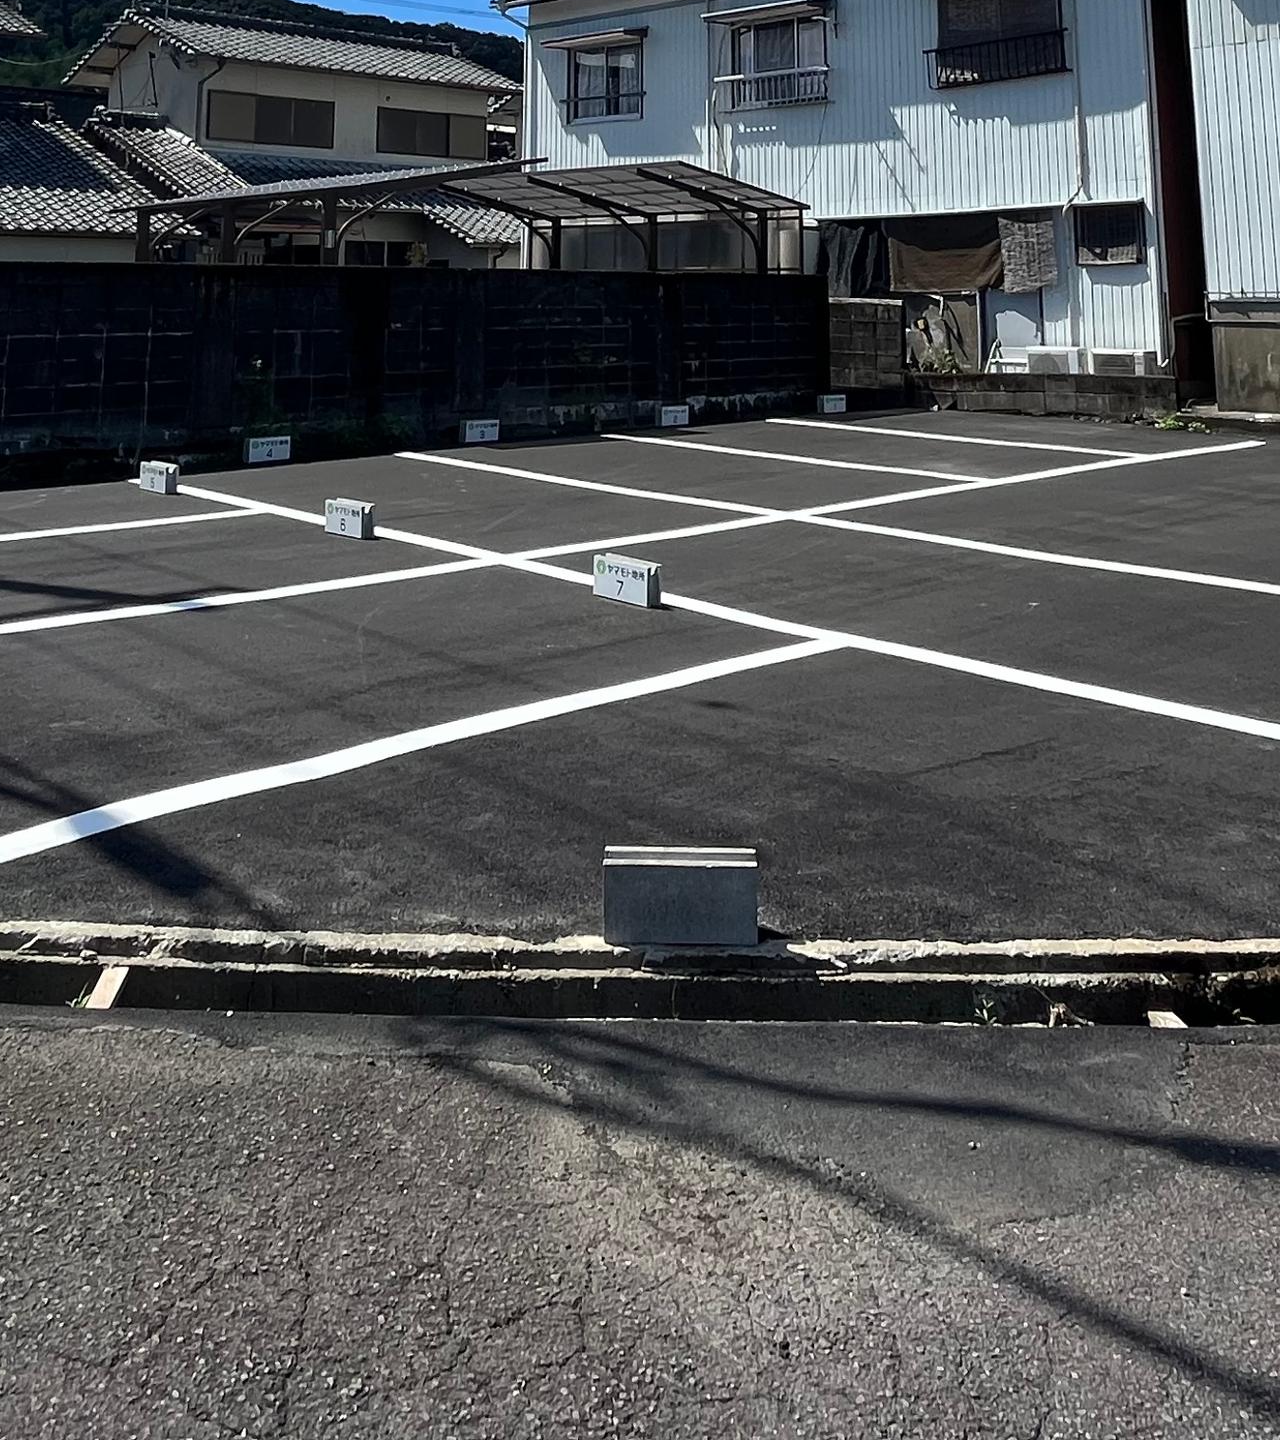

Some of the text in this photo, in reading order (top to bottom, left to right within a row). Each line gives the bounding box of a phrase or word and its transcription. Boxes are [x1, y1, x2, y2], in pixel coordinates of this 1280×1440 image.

[479, 430, 485, 439] 3
[266, 448, 273, 458] 4
[150, 477, 155, 489] 5
[340, 518, 346, 532] 6
[607, 564, 645, 581] ヤマモト地所
[616, 579, 624, 596] 7
